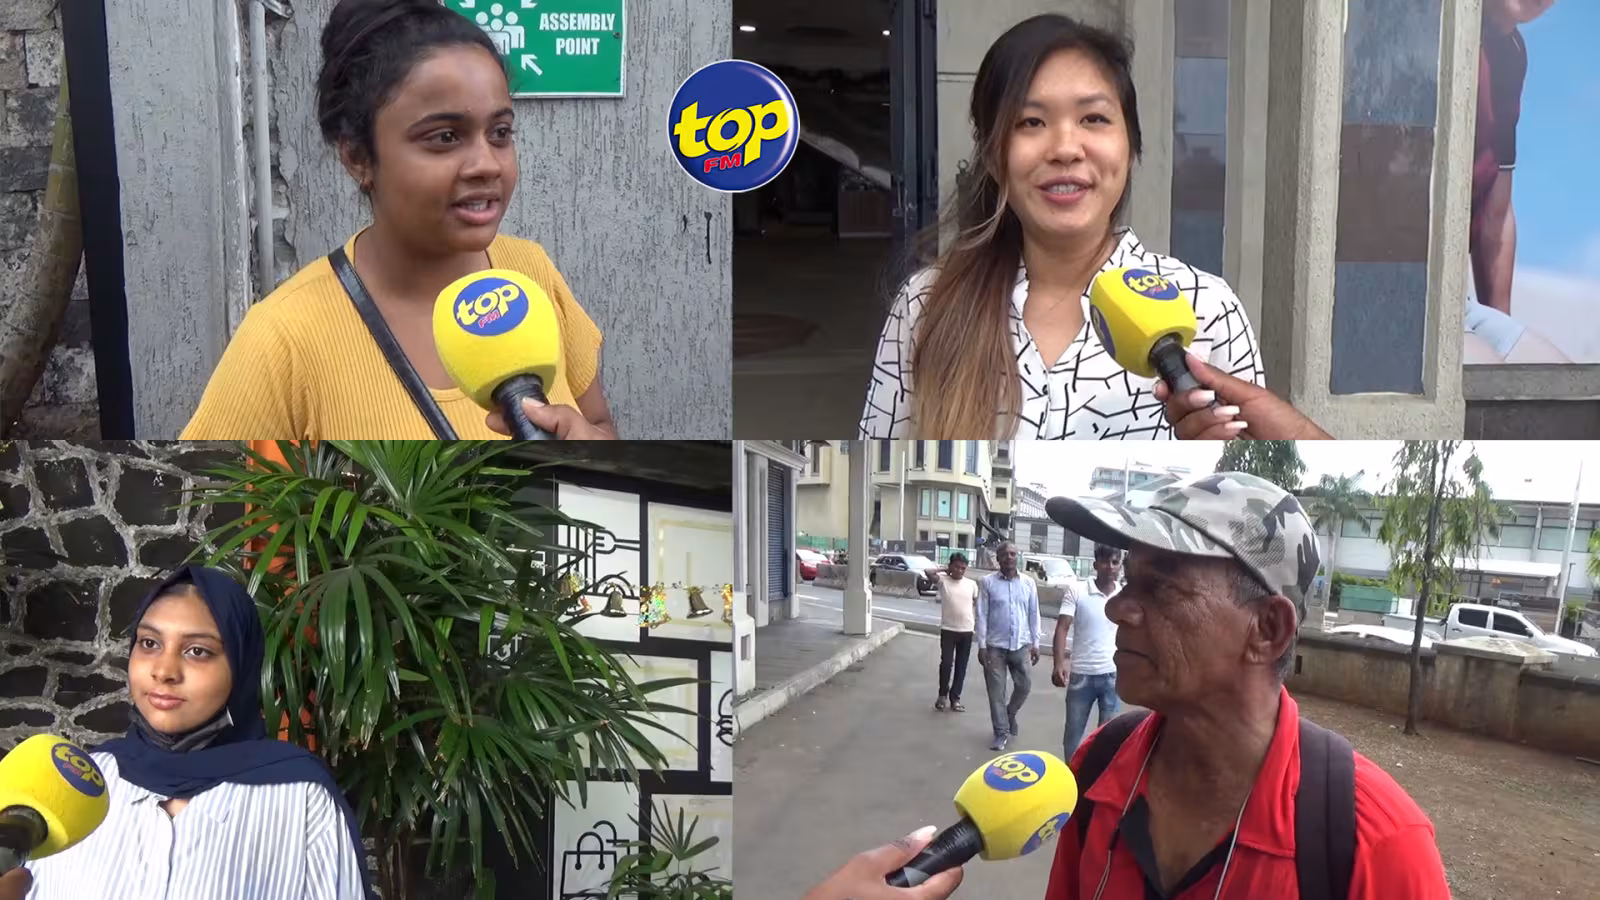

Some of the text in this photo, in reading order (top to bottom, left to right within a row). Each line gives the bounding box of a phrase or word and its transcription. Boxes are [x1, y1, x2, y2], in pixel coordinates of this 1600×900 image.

[539, 12, 616, 31] ASSEMBLY
[555, 37, 600, 56] POINT
[456, 284, 520, 326] top
